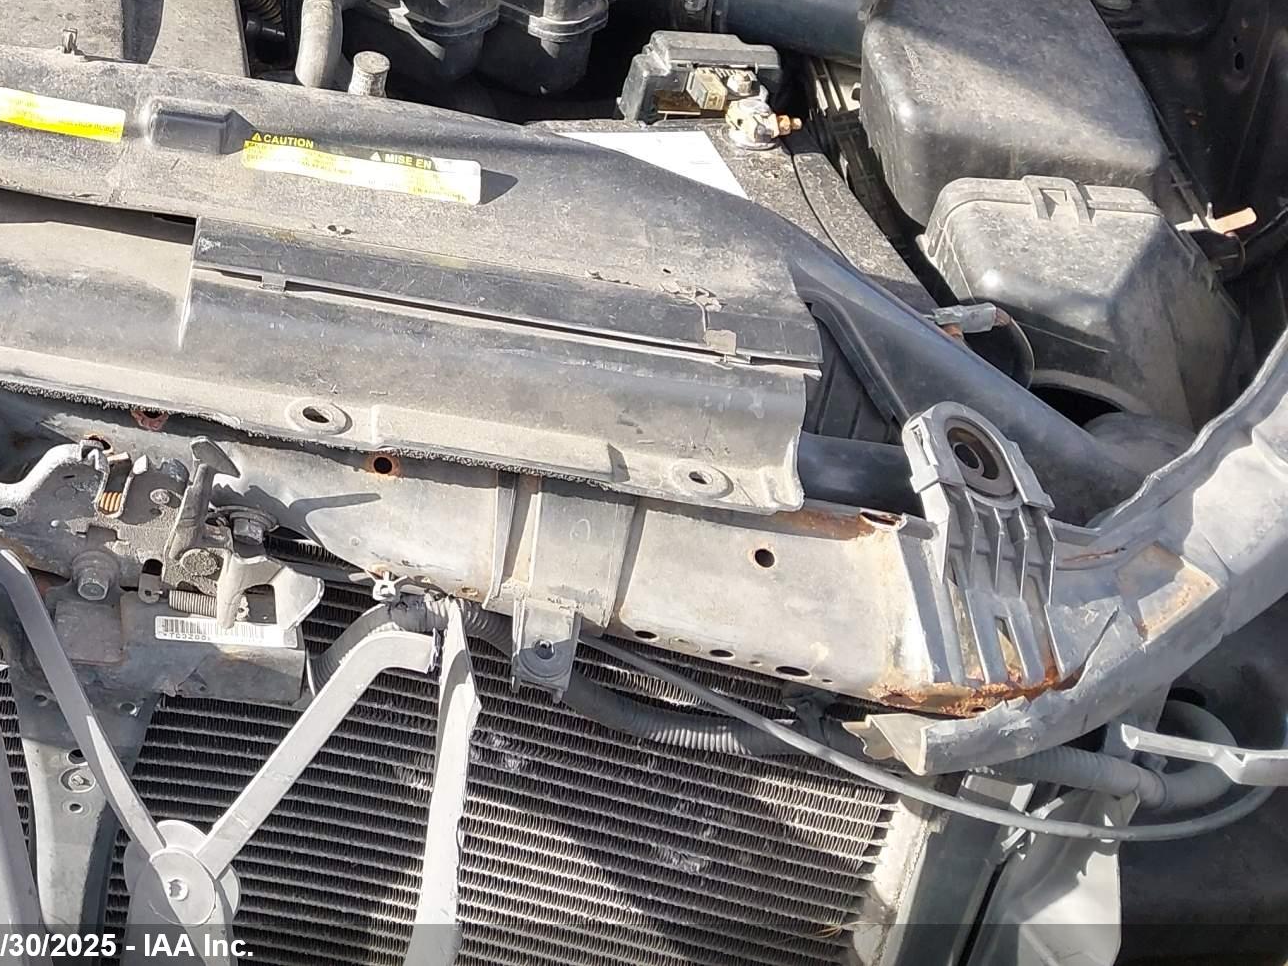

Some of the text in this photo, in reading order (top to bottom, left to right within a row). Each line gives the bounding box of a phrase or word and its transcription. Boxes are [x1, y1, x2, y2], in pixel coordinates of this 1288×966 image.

[263, 134, 314, 149] CAUTION
[384, 152, 413, 166] MISE
[415, 158, 432, 170] EN
